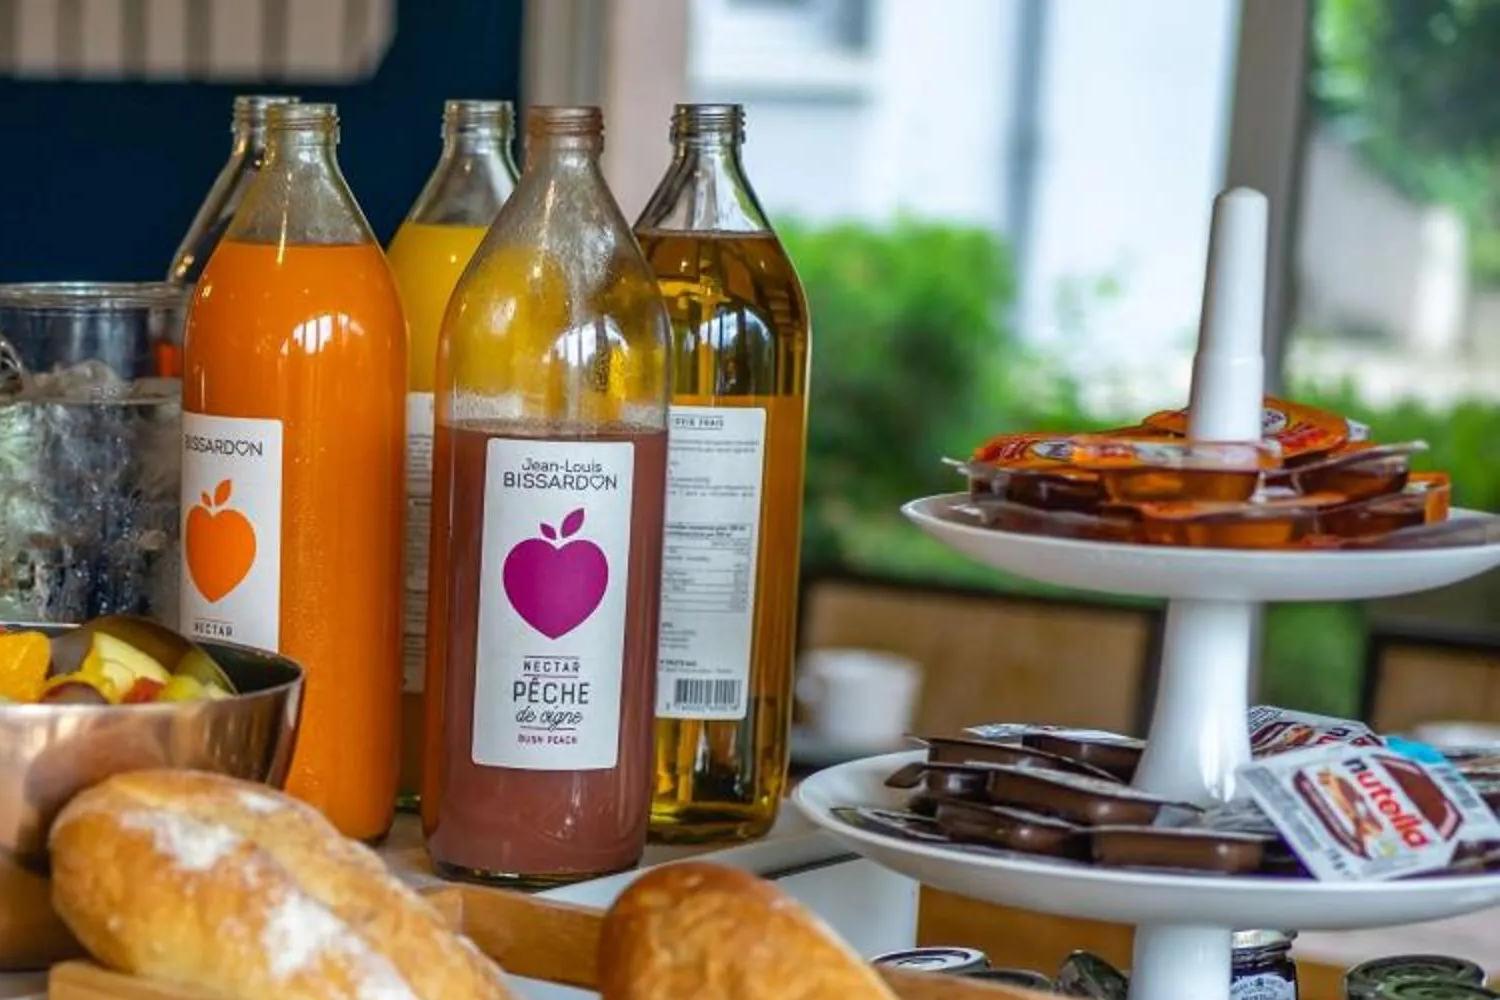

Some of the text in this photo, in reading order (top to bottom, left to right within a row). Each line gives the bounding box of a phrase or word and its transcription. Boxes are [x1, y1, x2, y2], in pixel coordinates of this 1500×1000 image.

[521, 457, 603, 473] Jean-Louis
[503, 471, 618, 491] BISSARDON
[523, 661, 581, 672] NECTAR
[513, 676, 590, 704] PÊCHE
[515, 705, 537, 722] de
[1342, 756, 1431, 850] nutella
